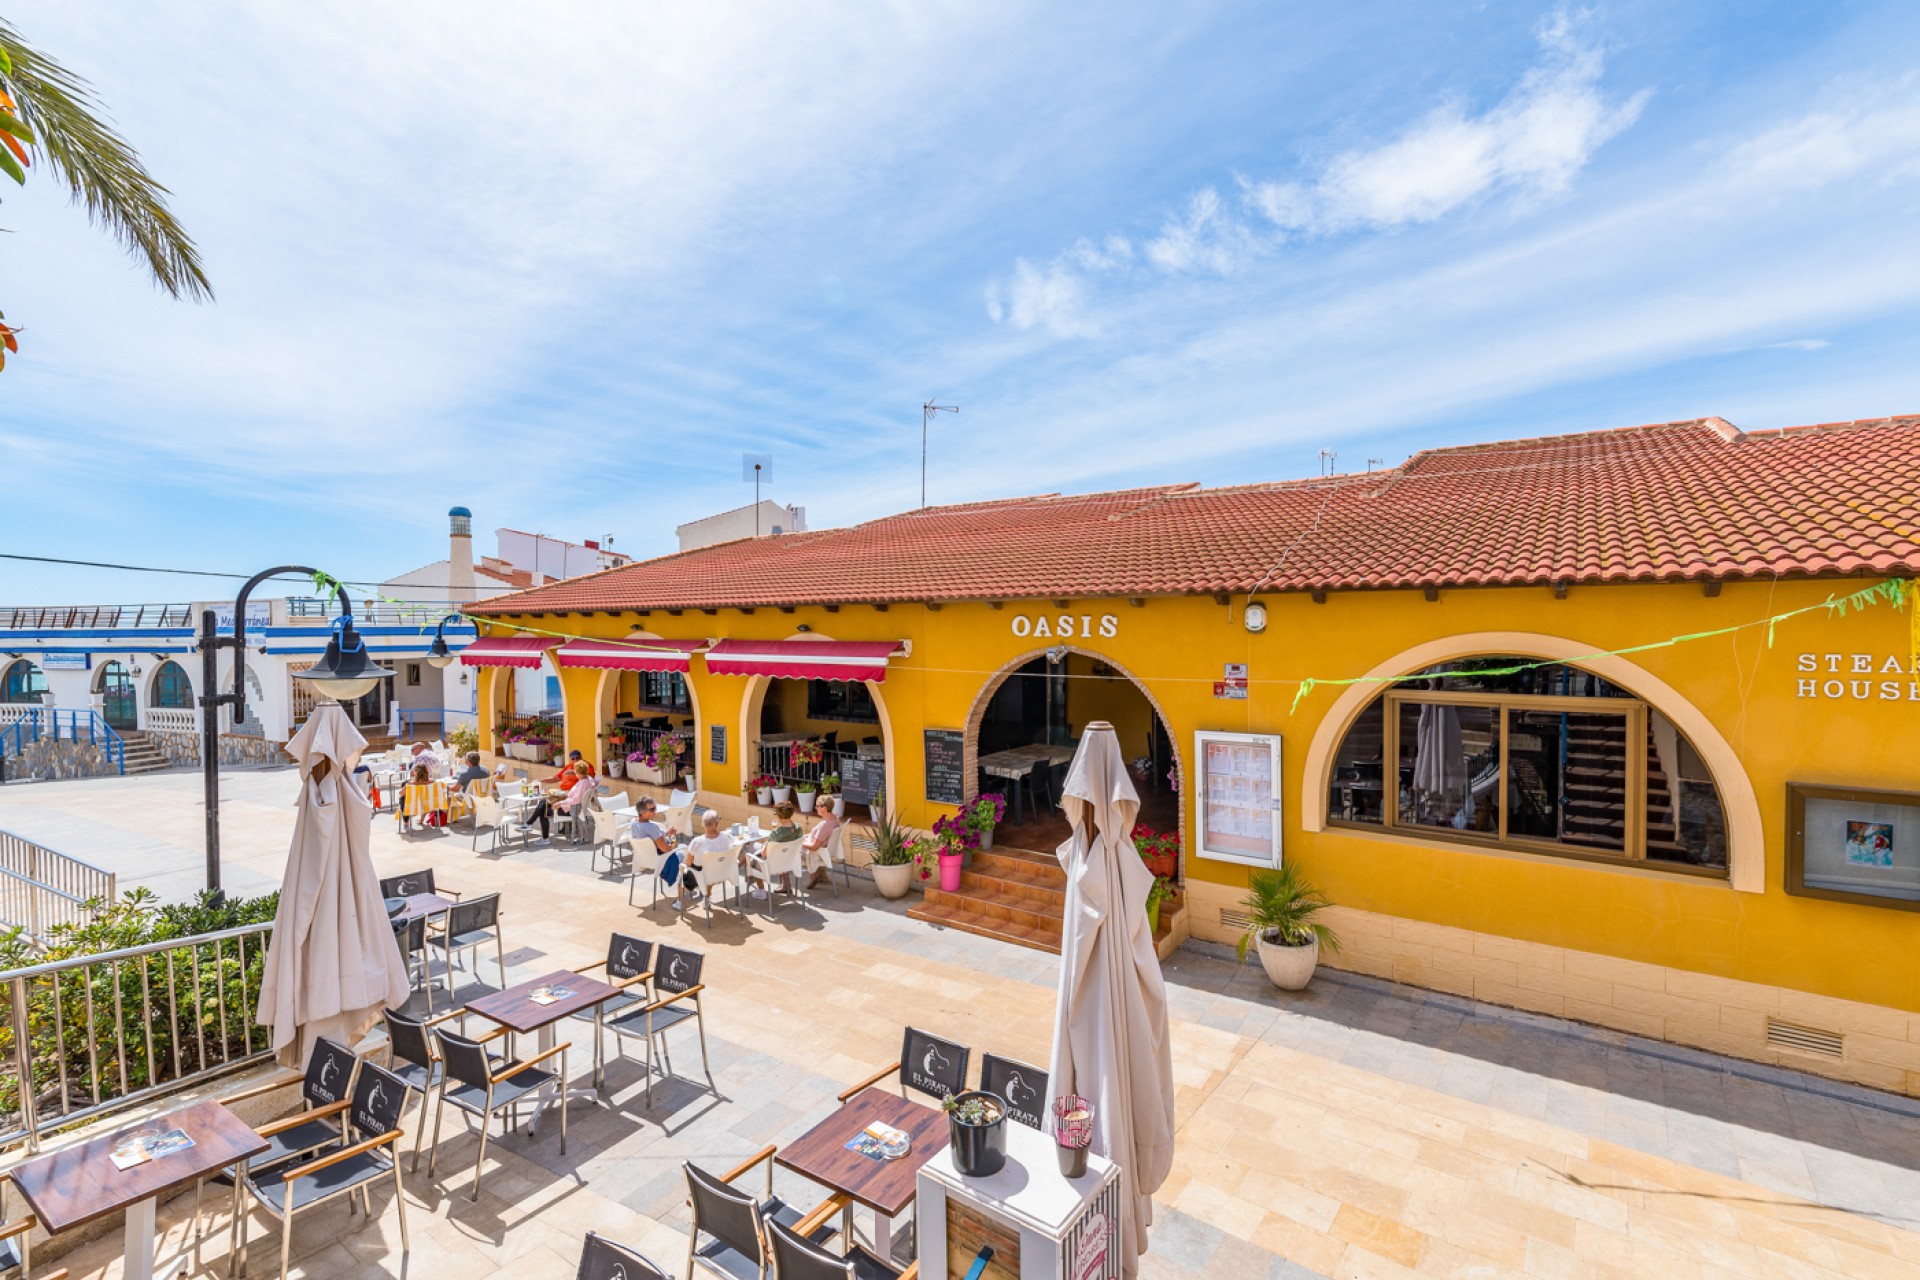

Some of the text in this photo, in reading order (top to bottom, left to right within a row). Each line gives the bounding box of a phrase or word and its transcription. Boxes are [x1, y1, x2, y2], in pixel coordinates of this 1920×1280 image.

[221, 614, 270, 627] Merránea
[1011, 615, 1118, 637] OASIS
[912, 1072, 922, 1082] EL
[924, 1077, 951, 1093] PIRATA
[359, 1110, 367, 1120] EL
[367, 1115, 385, 1133] PIRATA
[1008, 1106, 1039, 1124] PIRATA
